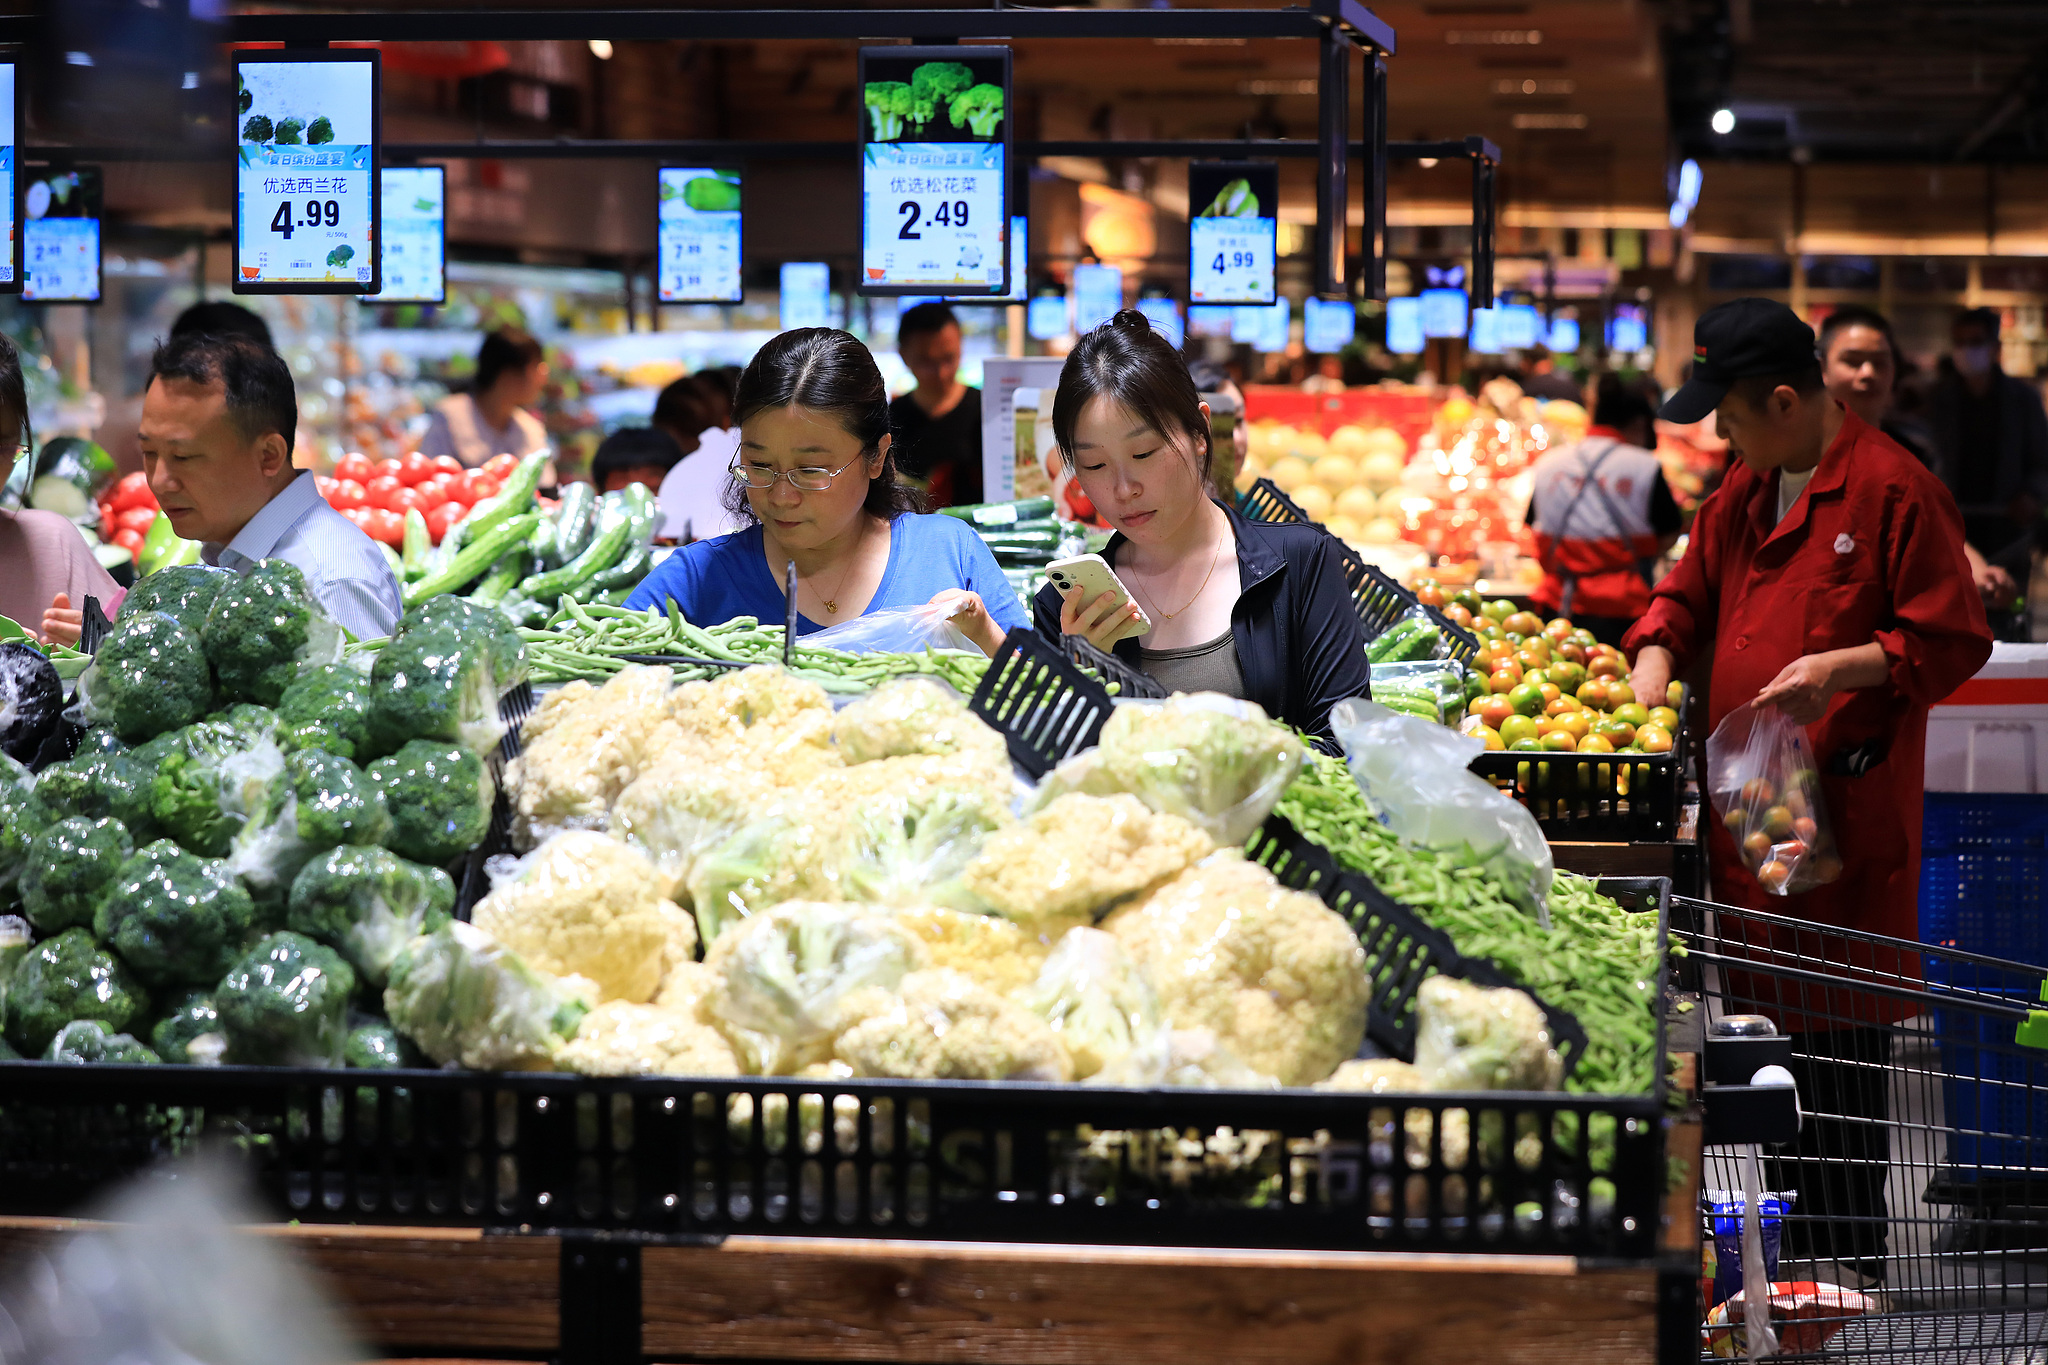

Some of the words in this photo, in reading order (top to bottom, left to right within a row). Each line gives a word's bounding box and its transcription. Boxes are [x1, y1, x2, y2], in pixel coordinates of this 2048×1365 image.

[263, 177, 348, 194] 优选西兰花
[890, 176, 977, 194] 优选松花菜
[270, 199, 340, 240] 4.99
[898, 200, 969, 240] 2.49
[1212, 252, 1254, 275] 4.99
